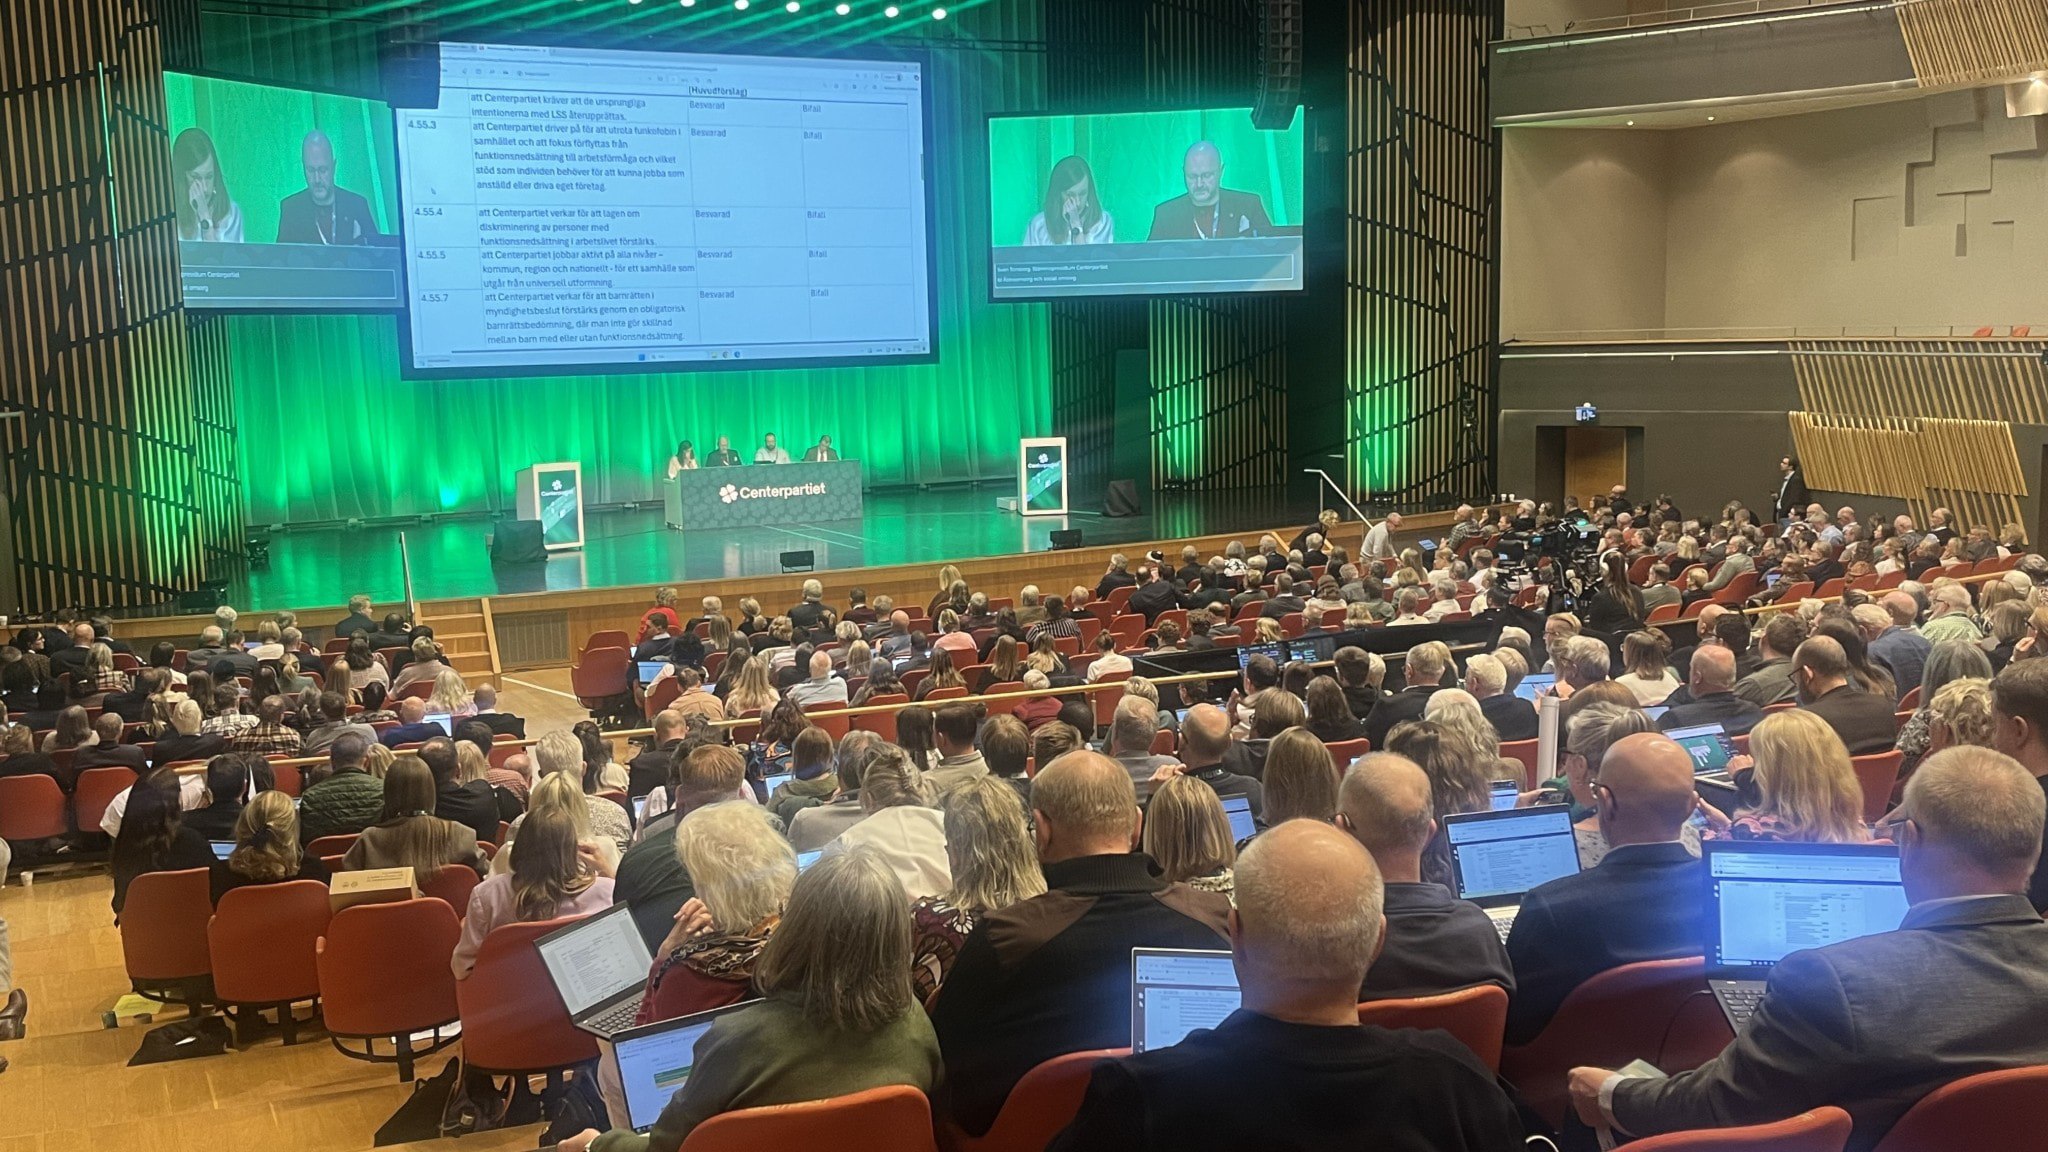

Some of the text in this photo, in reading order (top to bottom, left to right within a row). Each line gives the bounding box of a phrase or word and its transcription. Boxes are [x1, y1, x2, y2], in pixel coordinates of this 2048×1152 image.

[688, 86, 747, 97] (Huvudförslag)
[471, 93, 646, 109] att Centerpartiet kräver att de ursprungliga
[689, 101, 724, 109] Besvarad
[472, 108, 529, 118] intentionerna
[531, 109, 550, 118] med
[551, 110, 567, 119] LSS
[803, 105, 821, 113] Bifall
[408, 121, 436, 130] 4.55.3
[473, 123, 484, 131] att
[486, 122, 543, 134] Centerpartiet
[545, 124, 568, 133] driver
[570, 124, 581, 135] på
[582, 124, 594, 133] för
[595, 126, 606, 134] att
[608, 126, 632, 134] utrota
[691, 128, 726, 137] Besvarad
[804, 131, 822, 139] Bifall
[474, 136, 628, 150] samhället och att fokus förflyttas från
[475, 151, 676, 165] funktionsnedsättning till arbetsförmåga och vilket
[476, 166, 495, 174] stöd
[517, 166, 555, 175] individen
[556, 167, 589, 176] behöver
[591, 167, 603, 176] för
[605, 168, 616, 176] att
[617, 168, 642, 177] kunna
[644, 168, 666, 179] jobba
[477, 180, 511, 189] anställd
[513, 181, 531, 190] eller
[533, 181, 554, 190] driva
[555, 182, 574, 192] eget
[415, 208, 442, 216] 4.55.4
[479, 209, 490, 217] att
[492, 208, 549, 219] Centerpartiet
[551, 208, 576, 217] verkar
[577, 208, 589, 217] för
[590, 209, 601, 217] att
[603, 209, 625, 220] lagen
[696, 210, 730, 218] Besvarad
[808, 211, 826, 219] Bifall
[480, 222, 540, 233] diskriminering
[553, 225, 589, 233] personer
[591, 222, 609, 231] med
[481, 236, 569, 247] funktionsnedsättning
[575, 236, 618, 245] arbetslivet
[418, 252, 446, 260] 4.55.5
[482, 251, 493, 259] att
[495, 250, 551, 261] Centerpartiet
[552, 250, 579, 261] jobbar
[581, 250, 603, 258] aktivt
[605, 249, 615, 261] på
[617, 250, 631, 258] alla
[633, 249, 657, 258] nivåer
[698, 251, 732, 259] Besvarad
[809, 250, 827, 258] Bifall
[525, 264, 550, 275] region
[552, 264, 568, 273] och
[570, 263, 608, 272] nationellt
[614, 263, 626, 272] för
[628, 264, 639, 272] ett
[641, 263, 677, 272] samhälle
[484, 278, 506, 290] utgår
[508, 278, 525, 287] från
[526, 278, 567, 287] universell
[422, 294, 448, 302] 4.55.7
[485, 293, 497, 301] att
[498, 291, 554, 303] Centerpartiet
[555, 291, 580, 300] verkar
[582, 291, 594, 300] för
[596, 292, 607, 300] att
[608, 291, 651, 300] barnrätten
[700, 290, 734, 298] Besvarad
[811, 289, 829, 297] Bifall
[486, 305, 560, 317] myndighetsbeslut
[562, 305, 598, 314] förstärks
[600, 306, 628, 316] genom
[640, 303, 686, 315] obligatorisk
[575, 319, 589, 328] där
[611, 319, 626, 327] inte
[628, 318, 640, 329] gör
[642, 318, 673, 327] skillnad
[488, 334, 517, 343] mellan
[518, 334, 538, 343] barn
[539, 333, 558, 342] med
[559, 333, 578, 342] eller
[580, 333, 599, 341] utan
[740, 482, 826, 500] Centerpartiet
